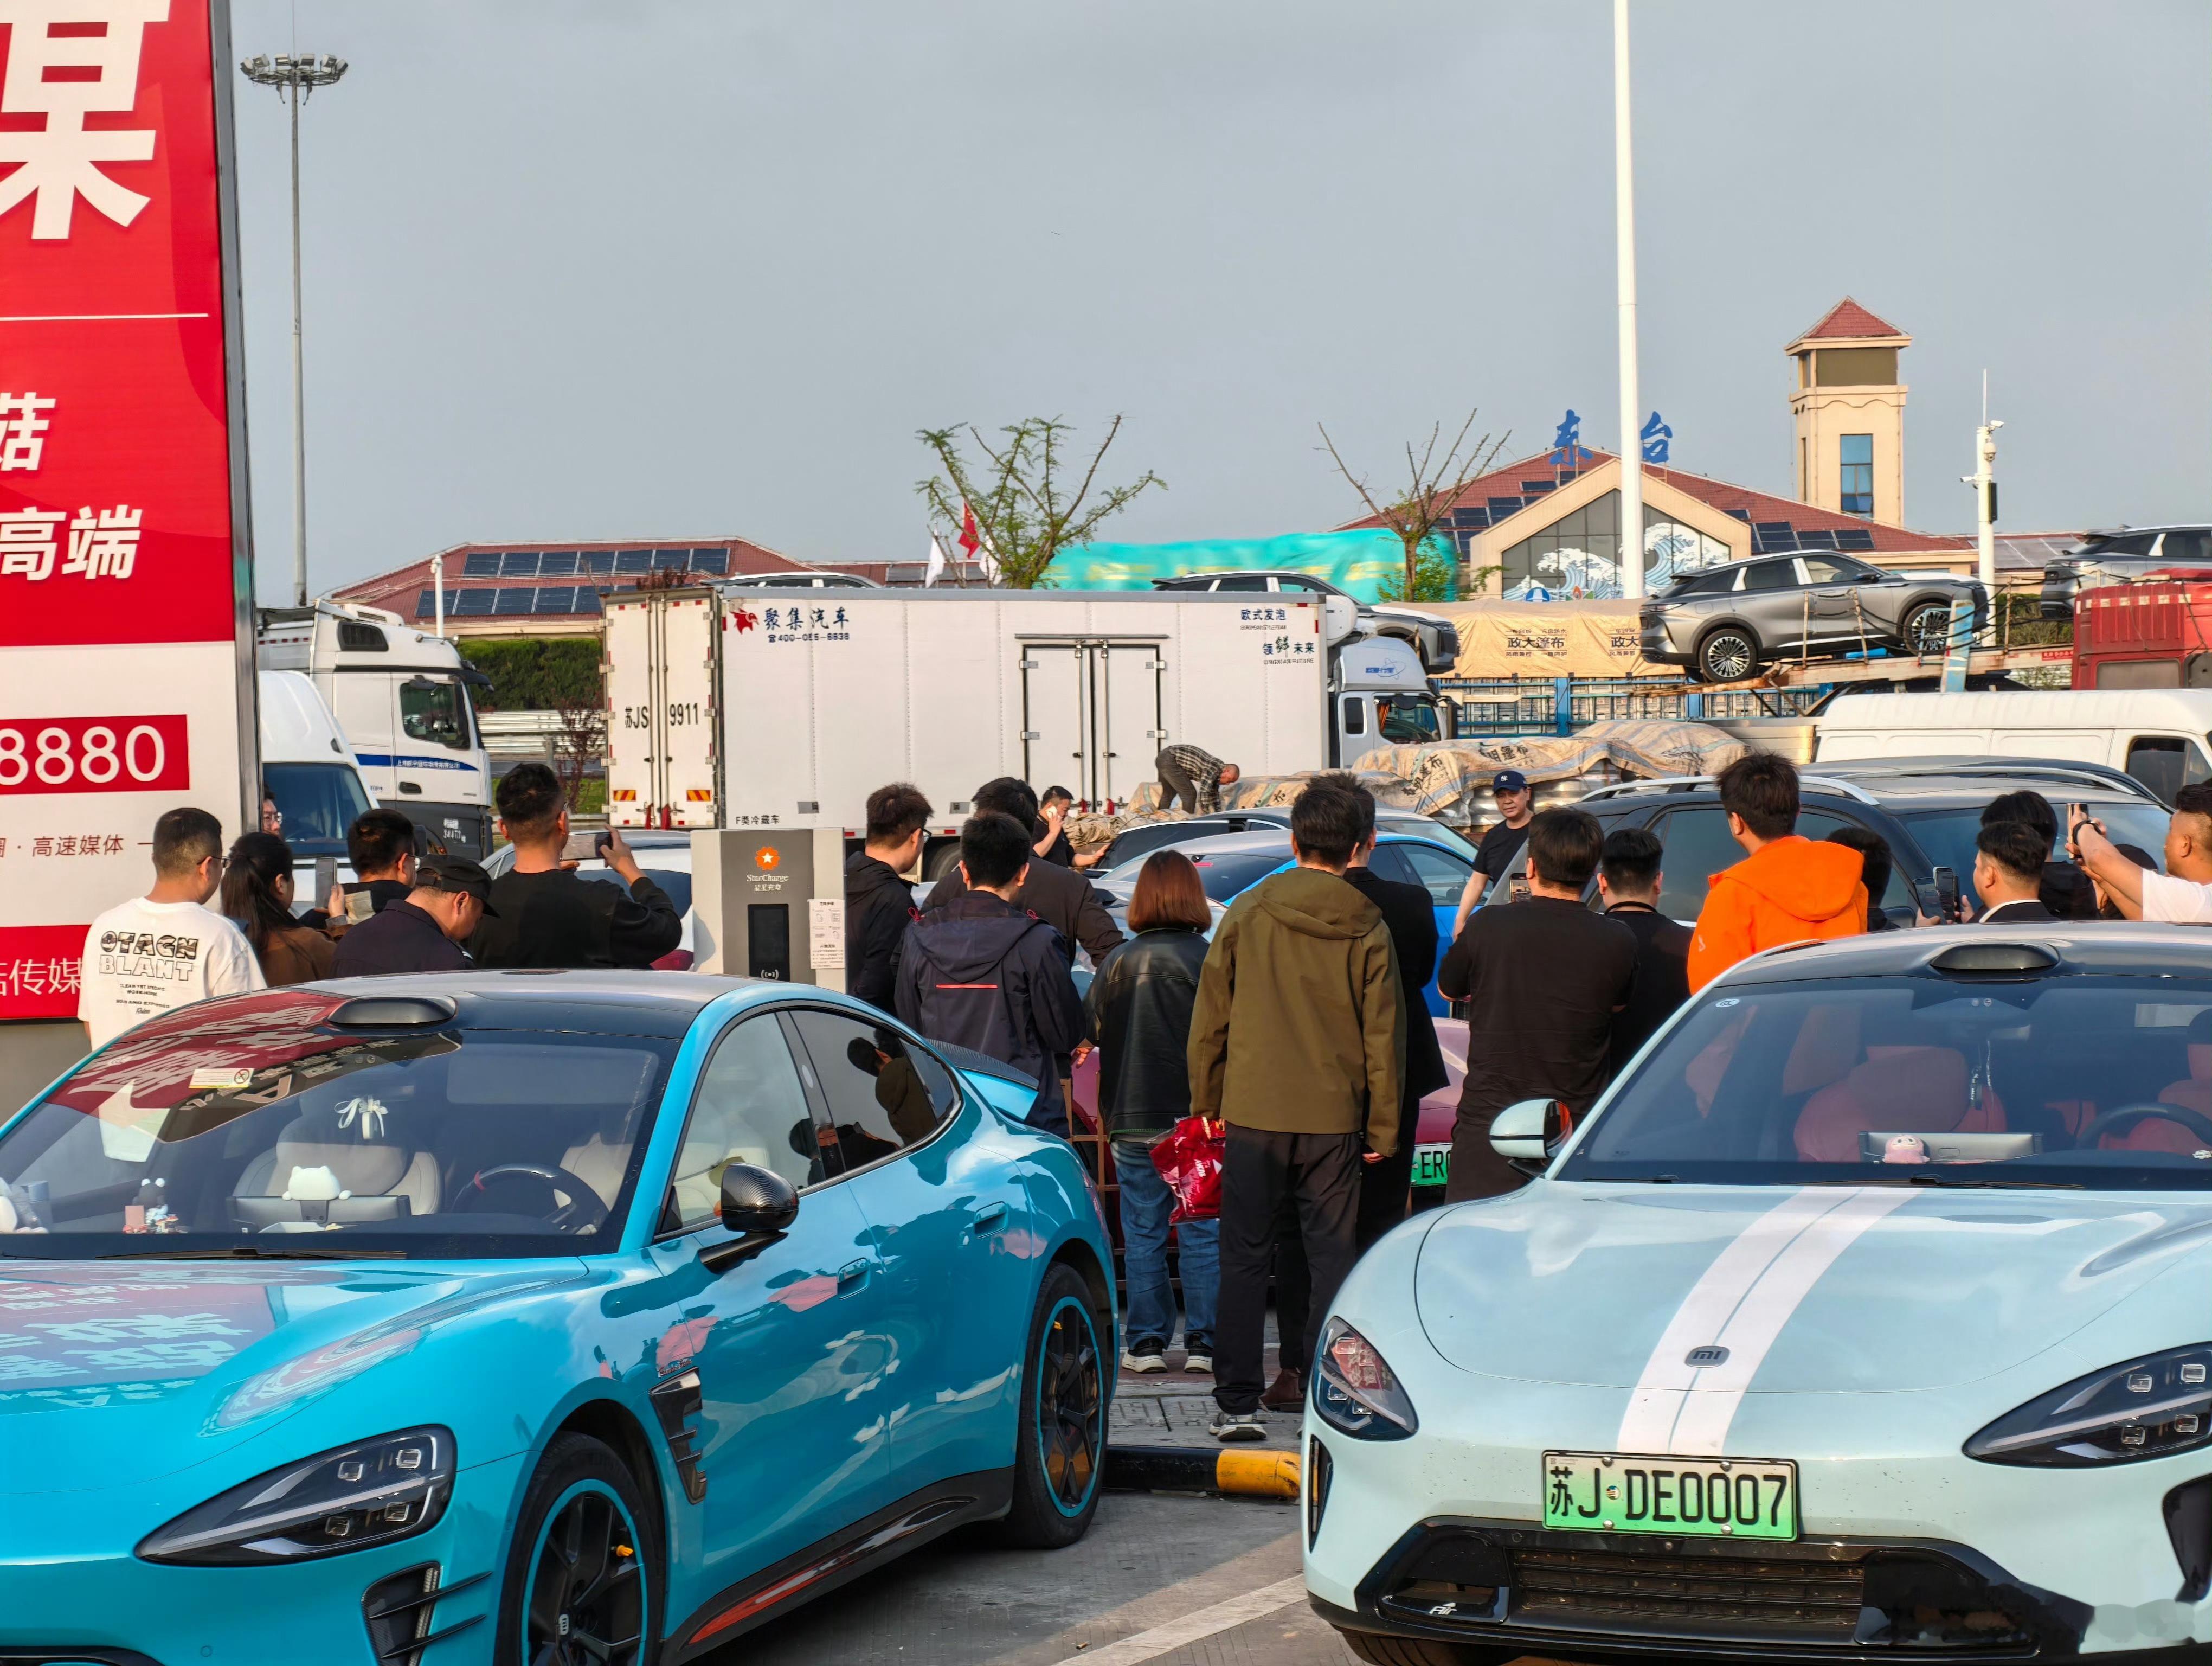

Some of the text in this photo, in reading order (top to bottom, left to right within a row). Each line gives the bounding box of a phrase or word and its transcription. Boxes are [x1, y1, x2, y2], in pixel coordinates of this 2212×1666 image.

[0, 504, 143, 581] 高端
[764, 606, 850, 631] 聚集汽车
[1508, 637, 1565, 649] 政大篷布
[625, 703, 698, 729] 苏JS 9911
[0, 725, 165, 786] 8880
[33, 834, 125, 857] 高速媒体
[747, 874, 790, 883] StarCharge
[0, 958, 83, 996] 传媒
[99, 954, 193, 981] BLANT
